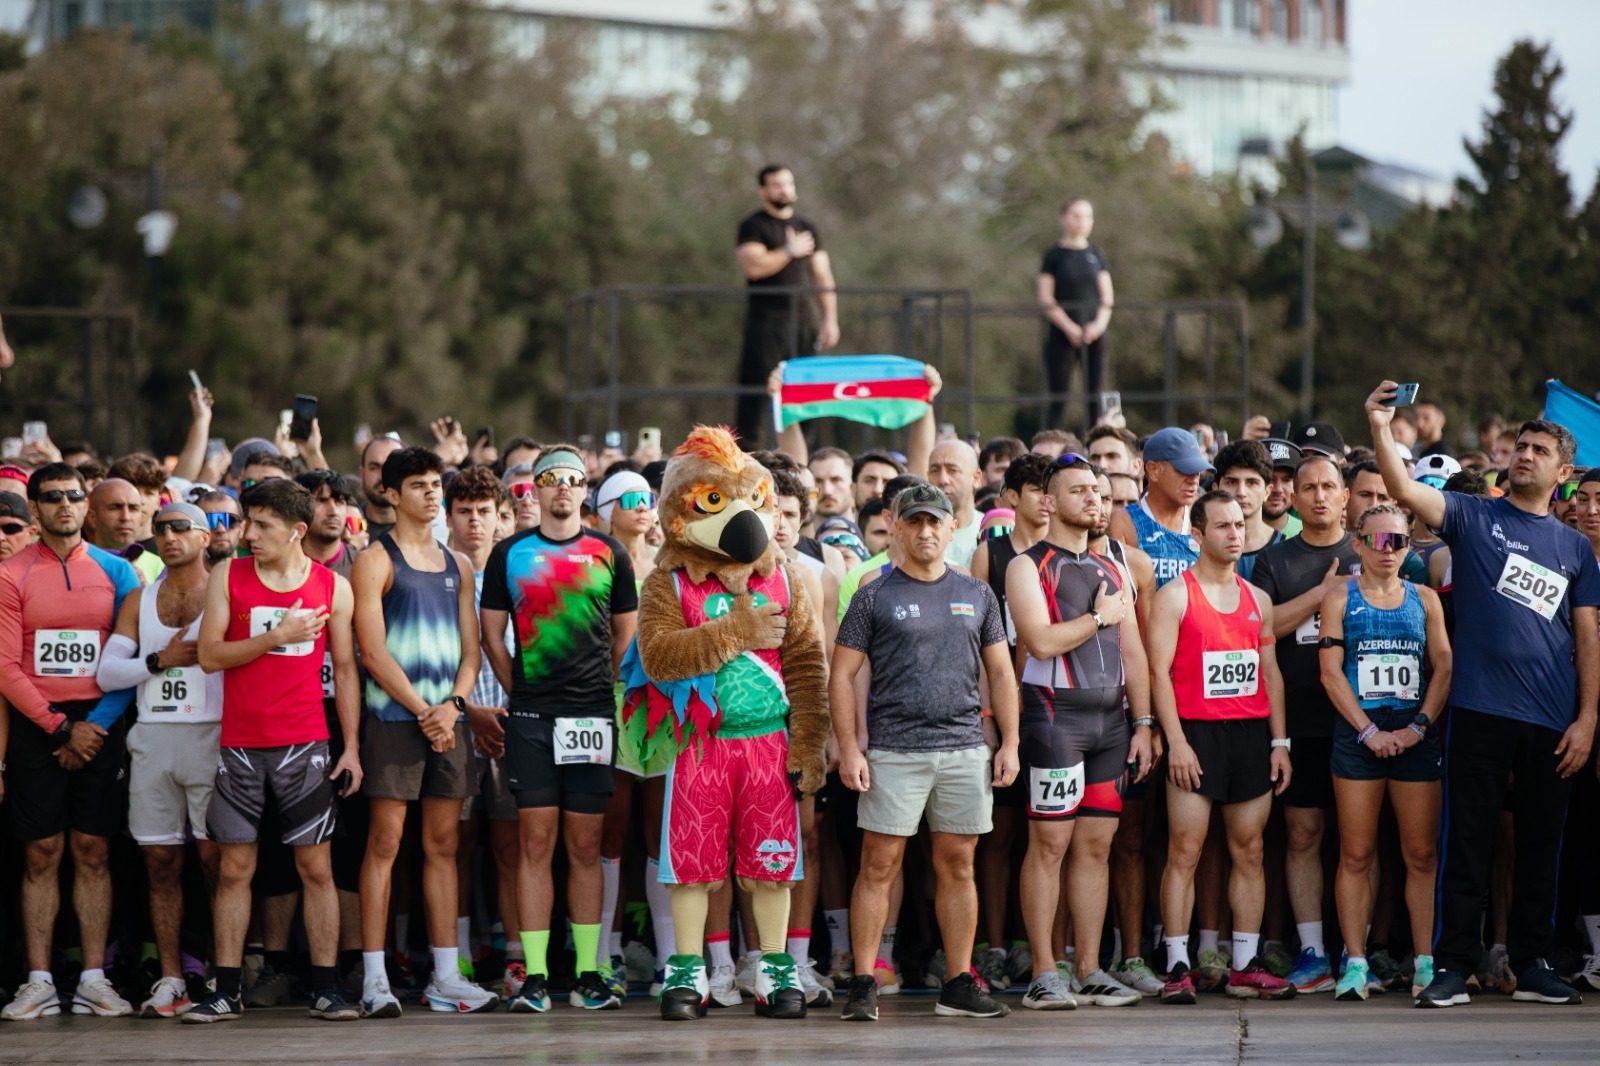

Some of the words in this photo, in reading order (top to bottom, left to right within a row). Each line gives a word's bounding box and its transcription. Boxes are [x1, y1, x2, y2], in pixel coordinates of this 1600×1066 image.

[1505, 565, 1559, 605] 2502
[40, 643, 96, 663] 2689
[1357, 640, 1420, 652] AZERBAIJAN
[1208, 663, 1256, 684] 2692
[1370, 666, 1411, 687] 110
[162, 681, 187, 701] 96
[565, 731, 604, 751] 300
[1039, 779, 1078, 800] 744
